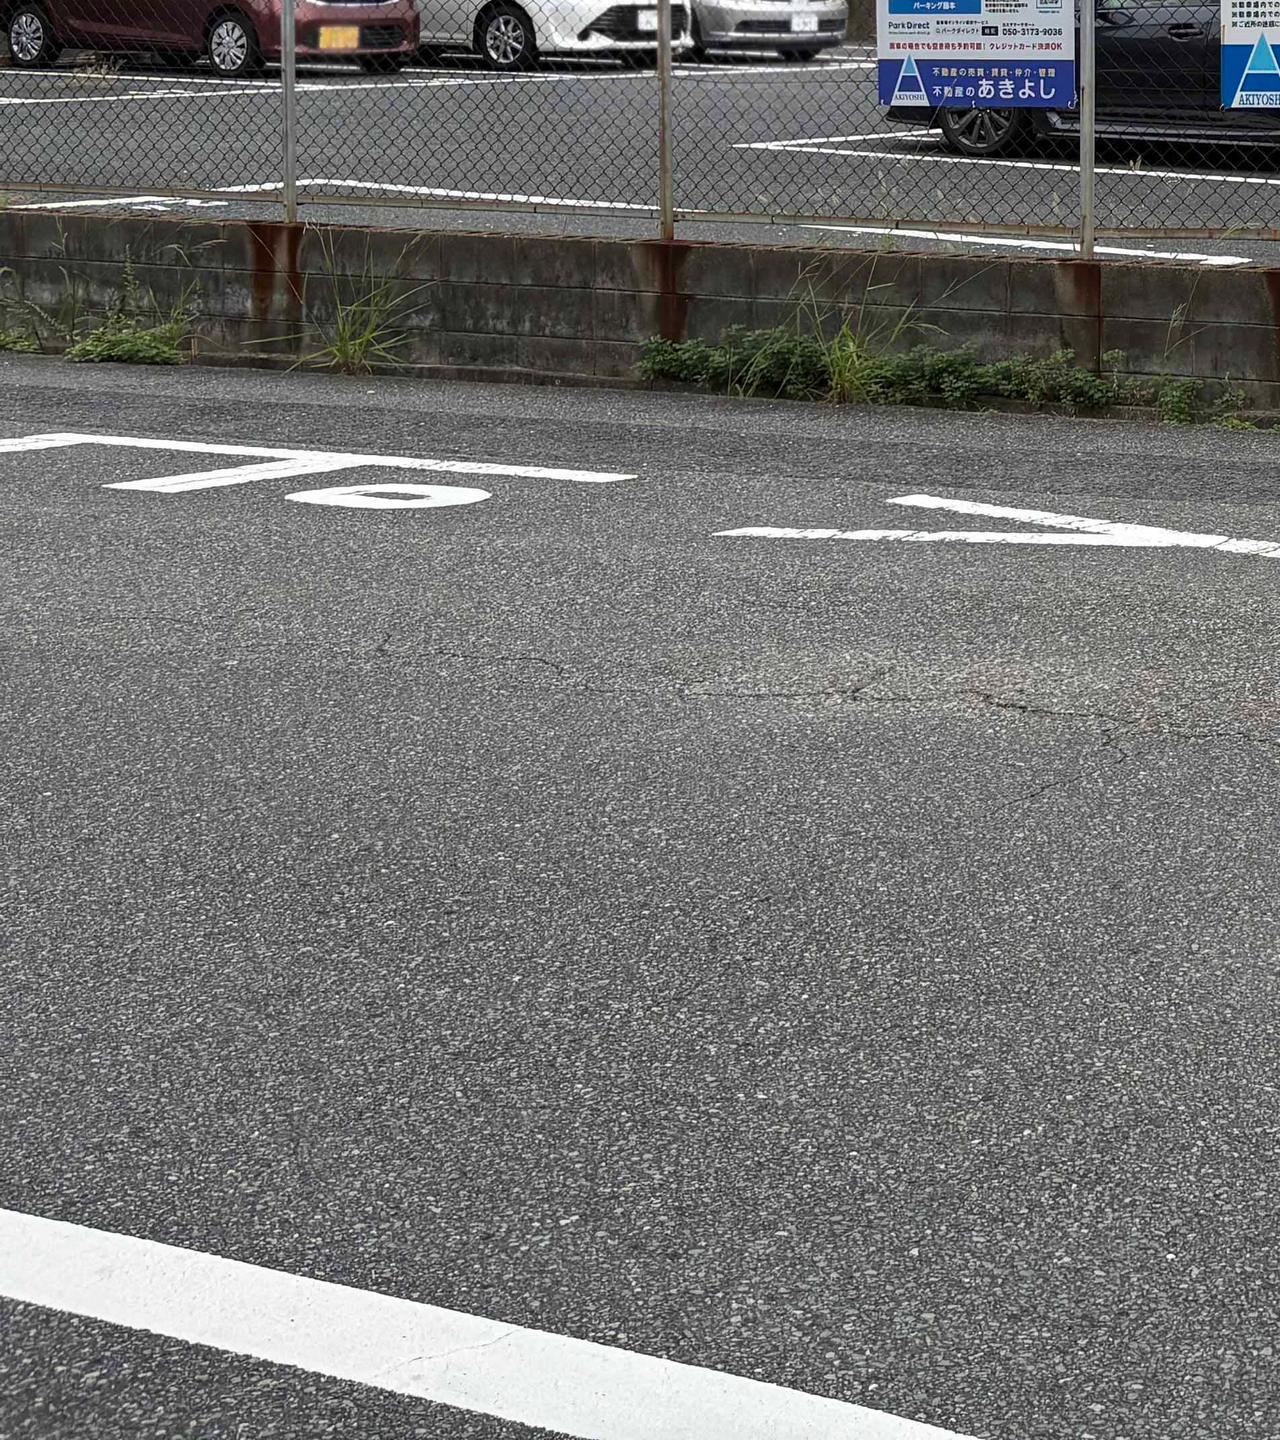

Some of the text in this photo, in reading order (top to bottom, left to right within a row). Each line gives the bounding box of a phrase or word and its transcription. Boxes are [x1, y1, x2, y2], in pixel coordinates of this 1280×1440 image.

[888, 21, 930, 30] Park Direct
[1002, 28, 1063, 36] 050-3173-9036
[932, 78, 1056, 99] 不動産のあきよし
[894, 93, 925, 101] AKIYOSHI
